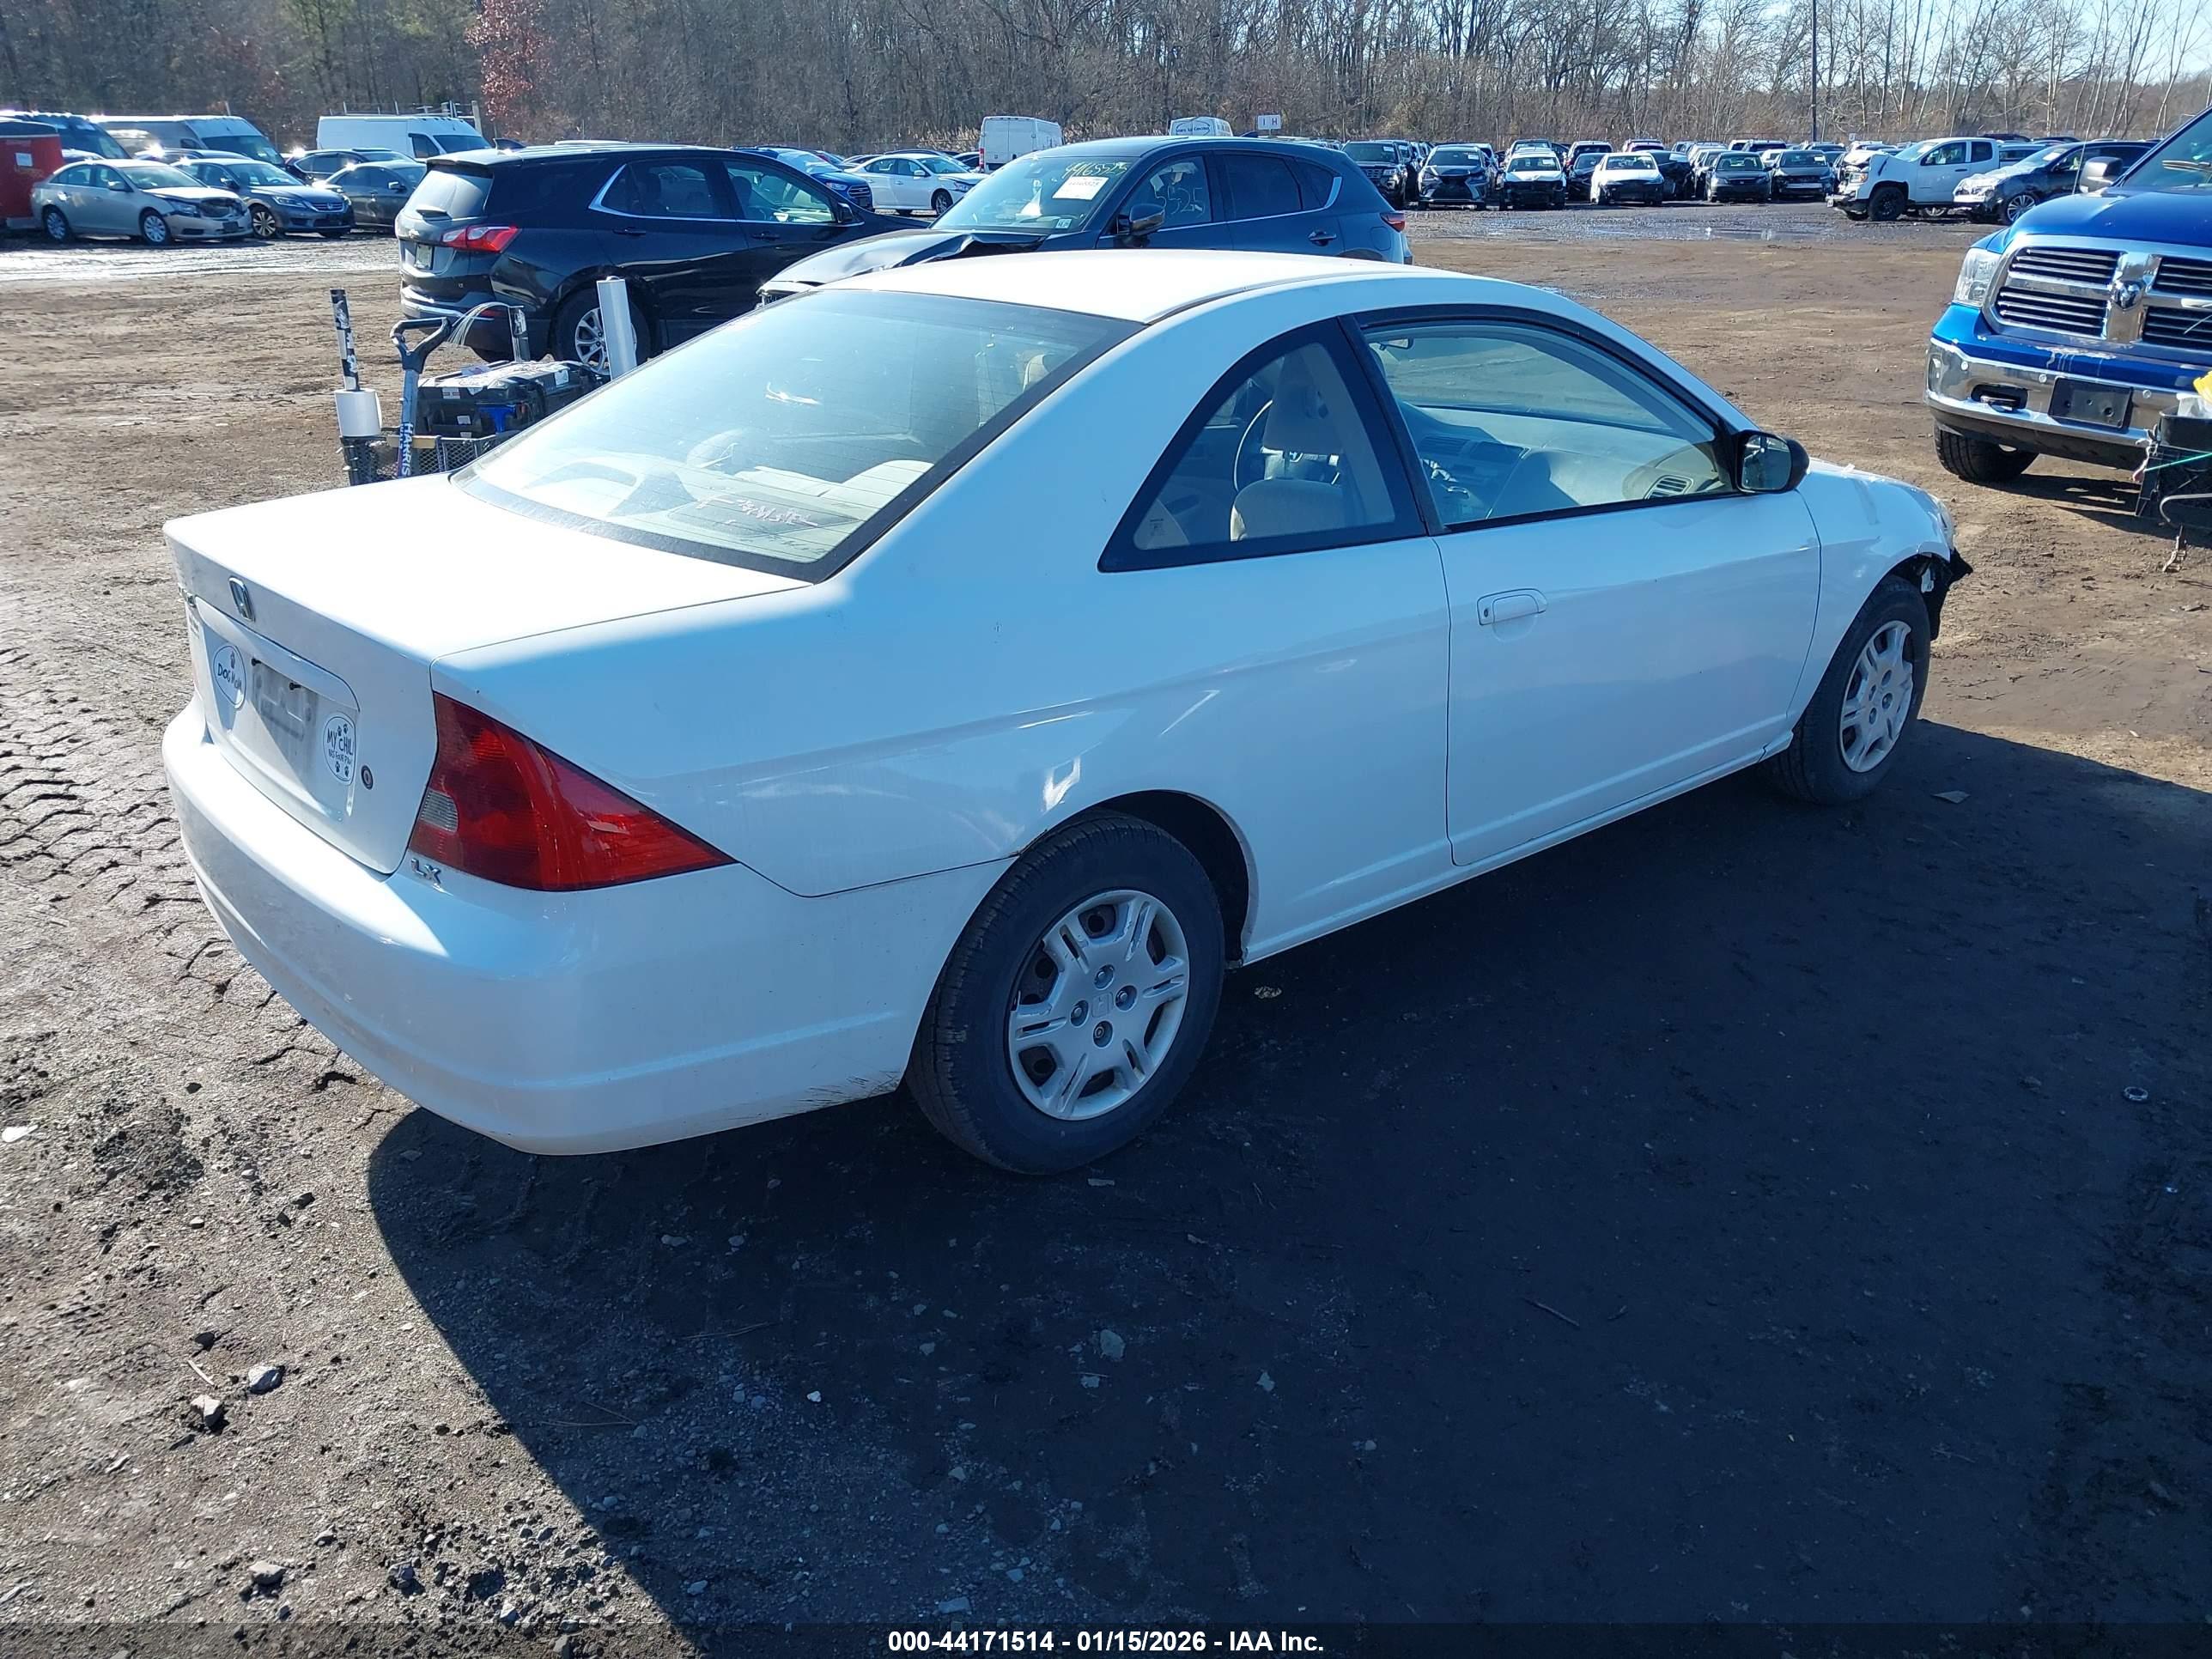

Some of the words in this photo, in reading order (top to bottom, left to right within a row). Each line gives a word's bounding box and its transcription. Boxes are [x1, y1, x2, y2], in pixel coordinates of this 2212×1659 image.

[401, 422, 414, 476] HARRIS
[217, 662, 231, 683] DOG
[326, 727, 337, 750] MY
[410, 858, 441, 887] LX
